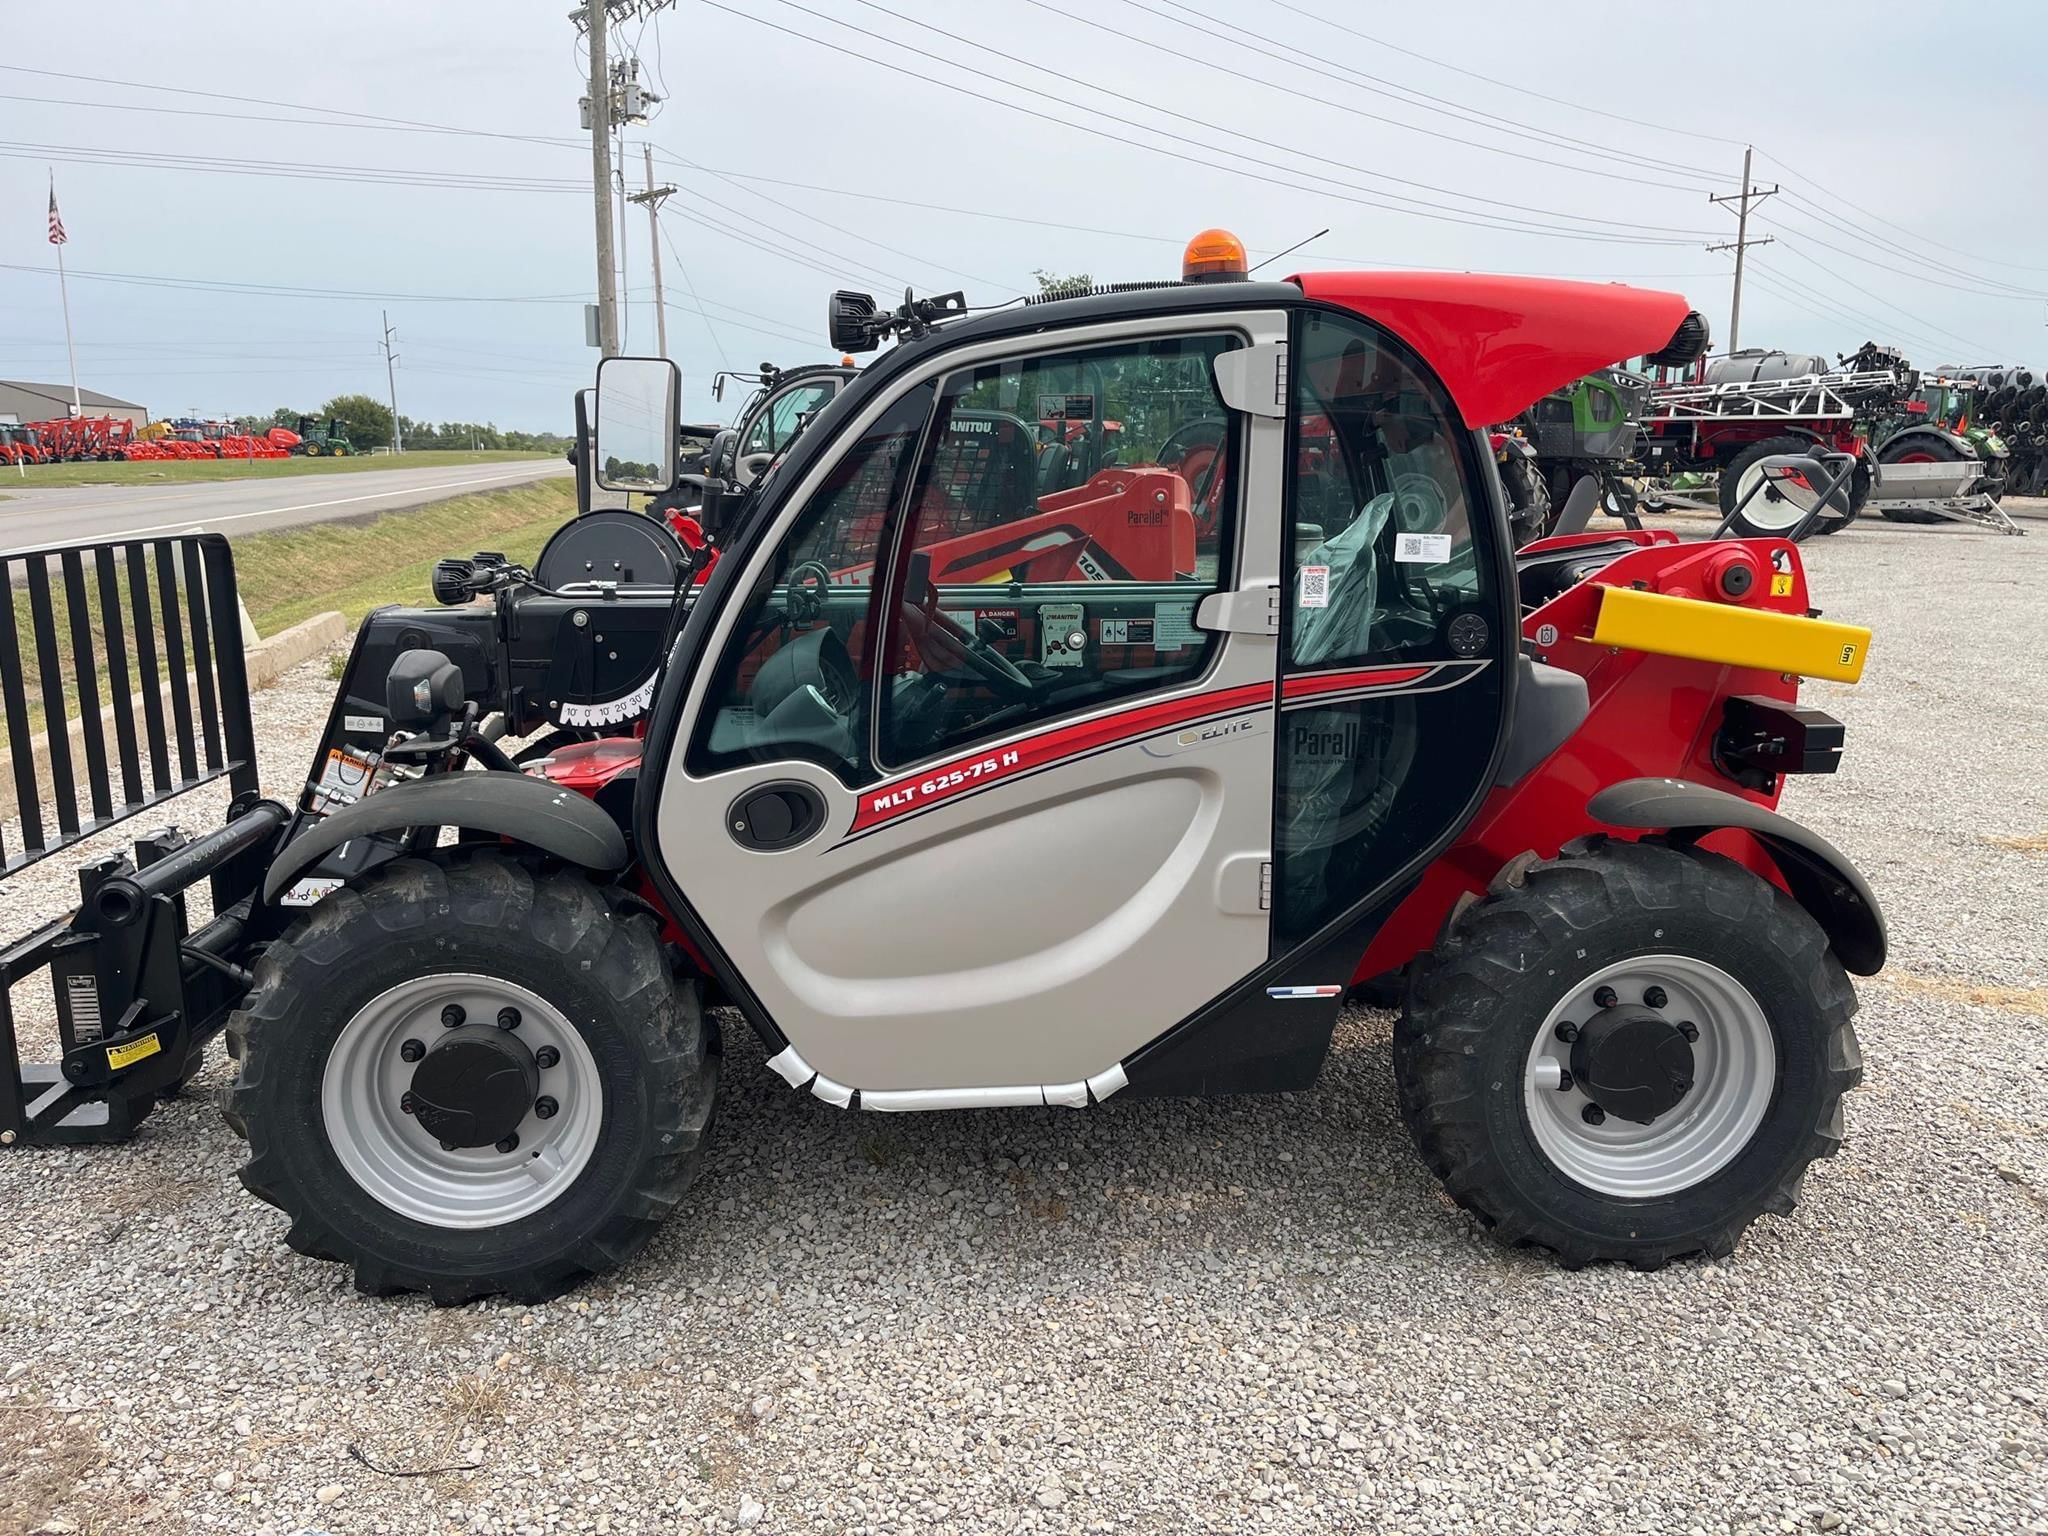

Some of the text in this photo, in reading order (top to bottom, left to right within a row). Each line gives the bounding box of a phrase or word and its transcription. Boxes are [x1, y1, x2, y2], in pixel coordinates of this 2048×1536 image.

[950, 421, 992, 433] ANITOU
[1128, 510, 1163, 526] Parallel
[1841, 646, 1854, 663] 6m
[1202, 717, 1254, 740] ELITE
[873, 750, 1019, 813] MLT 625-75 H
